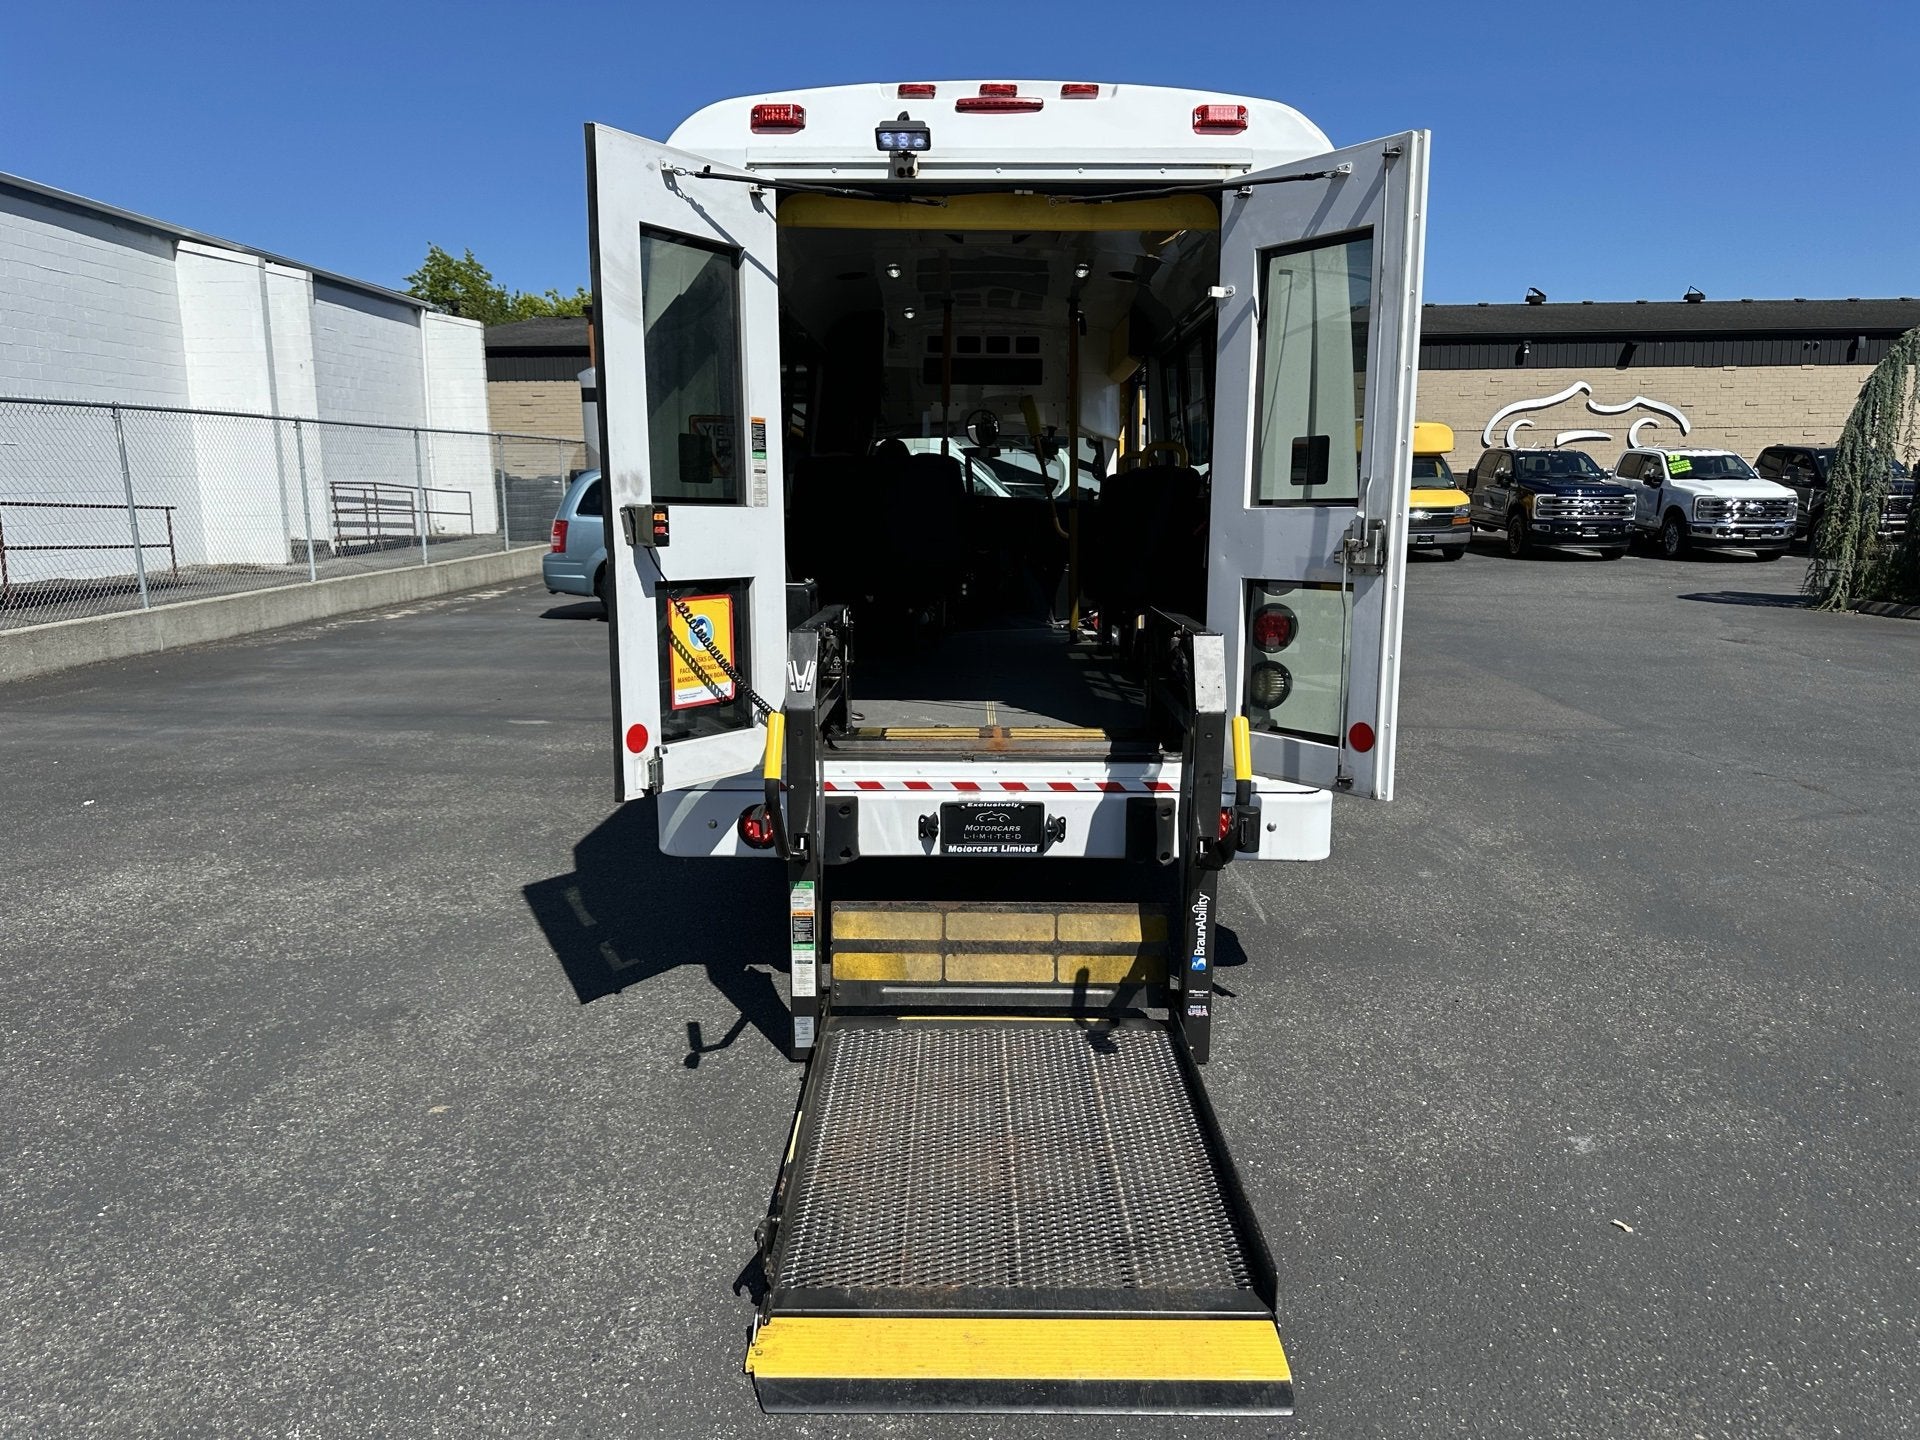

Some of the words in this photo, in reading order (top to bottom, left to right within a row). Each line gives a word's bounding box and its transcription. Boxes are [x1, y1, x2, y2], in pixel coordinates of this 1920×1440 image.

[703, 425, 734, 437] YIEL
[964, 824, 1021, 832] MOTORCARS
[948, 845, 998, 853] Motorcars
[1001, 844, 1038, 853] Limited
[1191, 892, 1211, 956] BraunAbility
